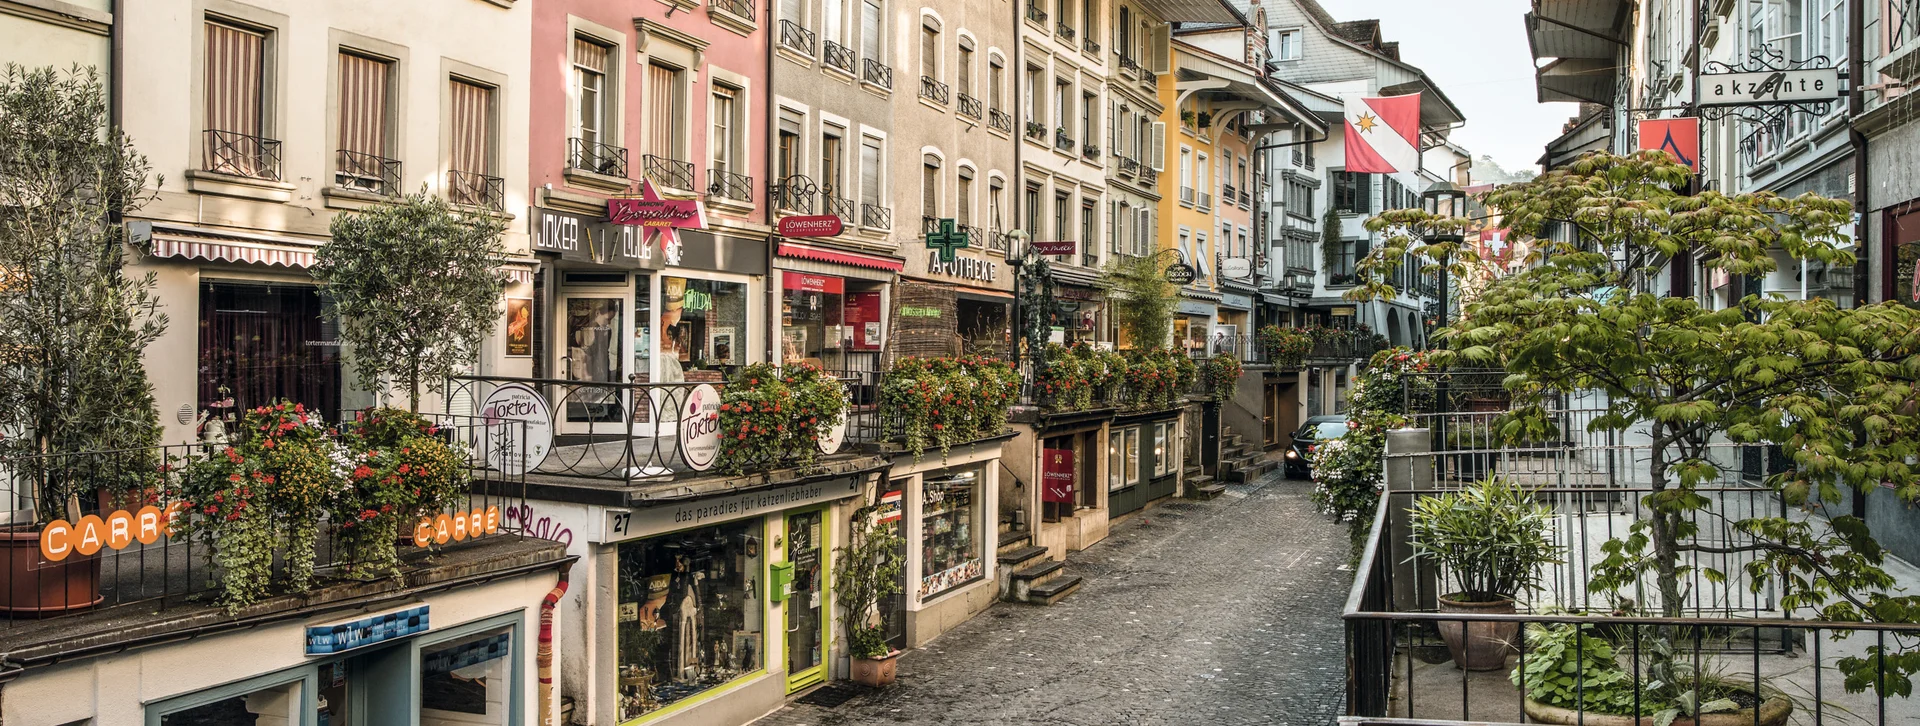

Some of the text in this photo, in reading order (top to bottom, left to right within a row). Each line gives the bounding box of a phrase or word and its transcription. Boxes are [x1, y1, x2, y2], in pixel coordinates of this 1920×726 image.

[1714, 78, 1824, 96] akzente
[537, 213, 578, 251] JOKER
[932, 251, 997, 281] APOTHEKE
[666, 285, 683, 296] AIDA
[489, 398, 537, 419] Torten
[702, 402, 720, 412] patricia
[849, 475, 859, 493] 27
[675, 486, 823, 524] das paradies für katzenliebhaber
[929, 490, 945, 504] Shop
[48, 502, 183, 554] CARRÉ
[418, 506, 496, 542] CARRÉ
[614, 512, 631, 536] 27
[649, 580, 667, 590] AIDA
[308, 635, 330, 645] wlw
[338, 626, 364, 645] wlw
